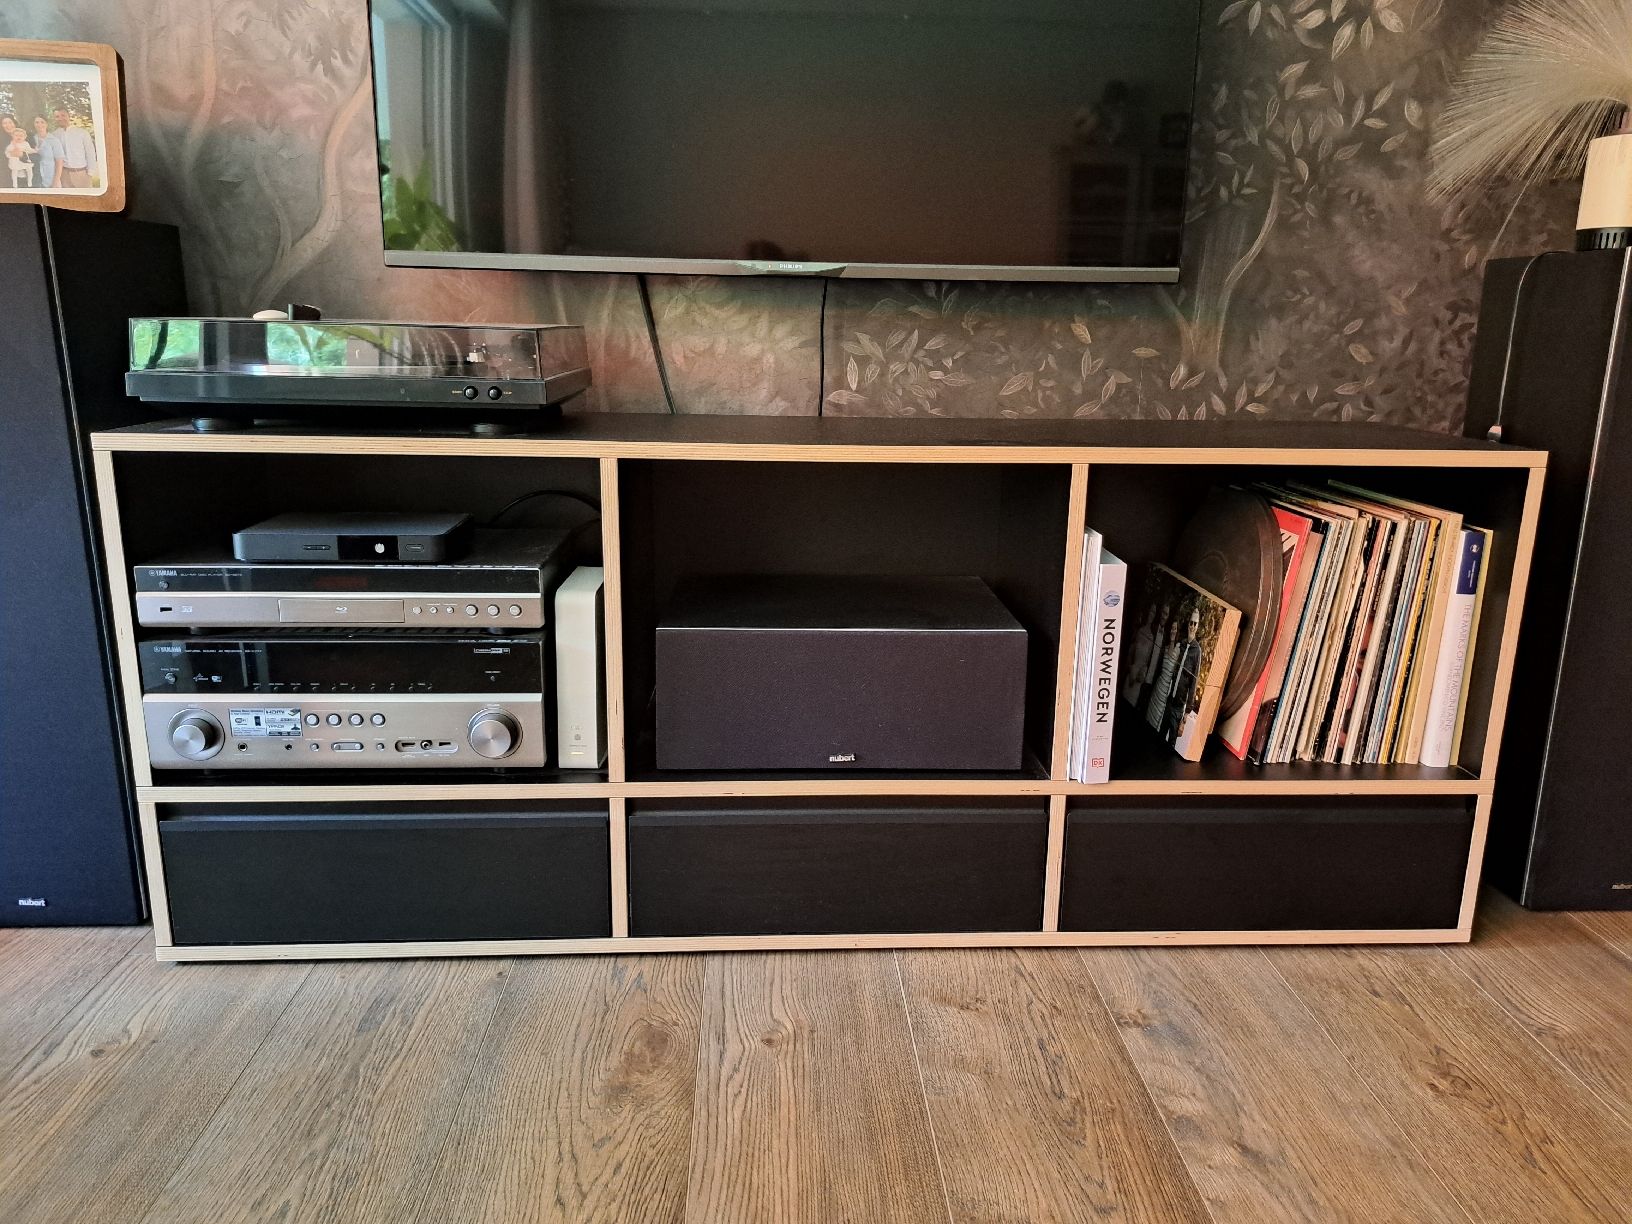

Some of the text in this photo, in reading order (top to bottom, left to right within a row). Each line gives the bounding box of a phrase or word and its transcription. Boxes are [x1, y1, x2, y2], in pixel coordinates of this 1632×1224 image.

[1462, 603, 1472, 618] THE
[1456, 619, 1469, 649] MARKS
[1455, 651, 1464, 664] OF
[1096, 618, 1117, 723] NORWEGEN
[1453, 664, 1463, 681] THE
[1445, 680, 1460, 731] MOUNTAINS
[829, 753, 855, 762] nubert
[18, 898, 46, 907] nubert
